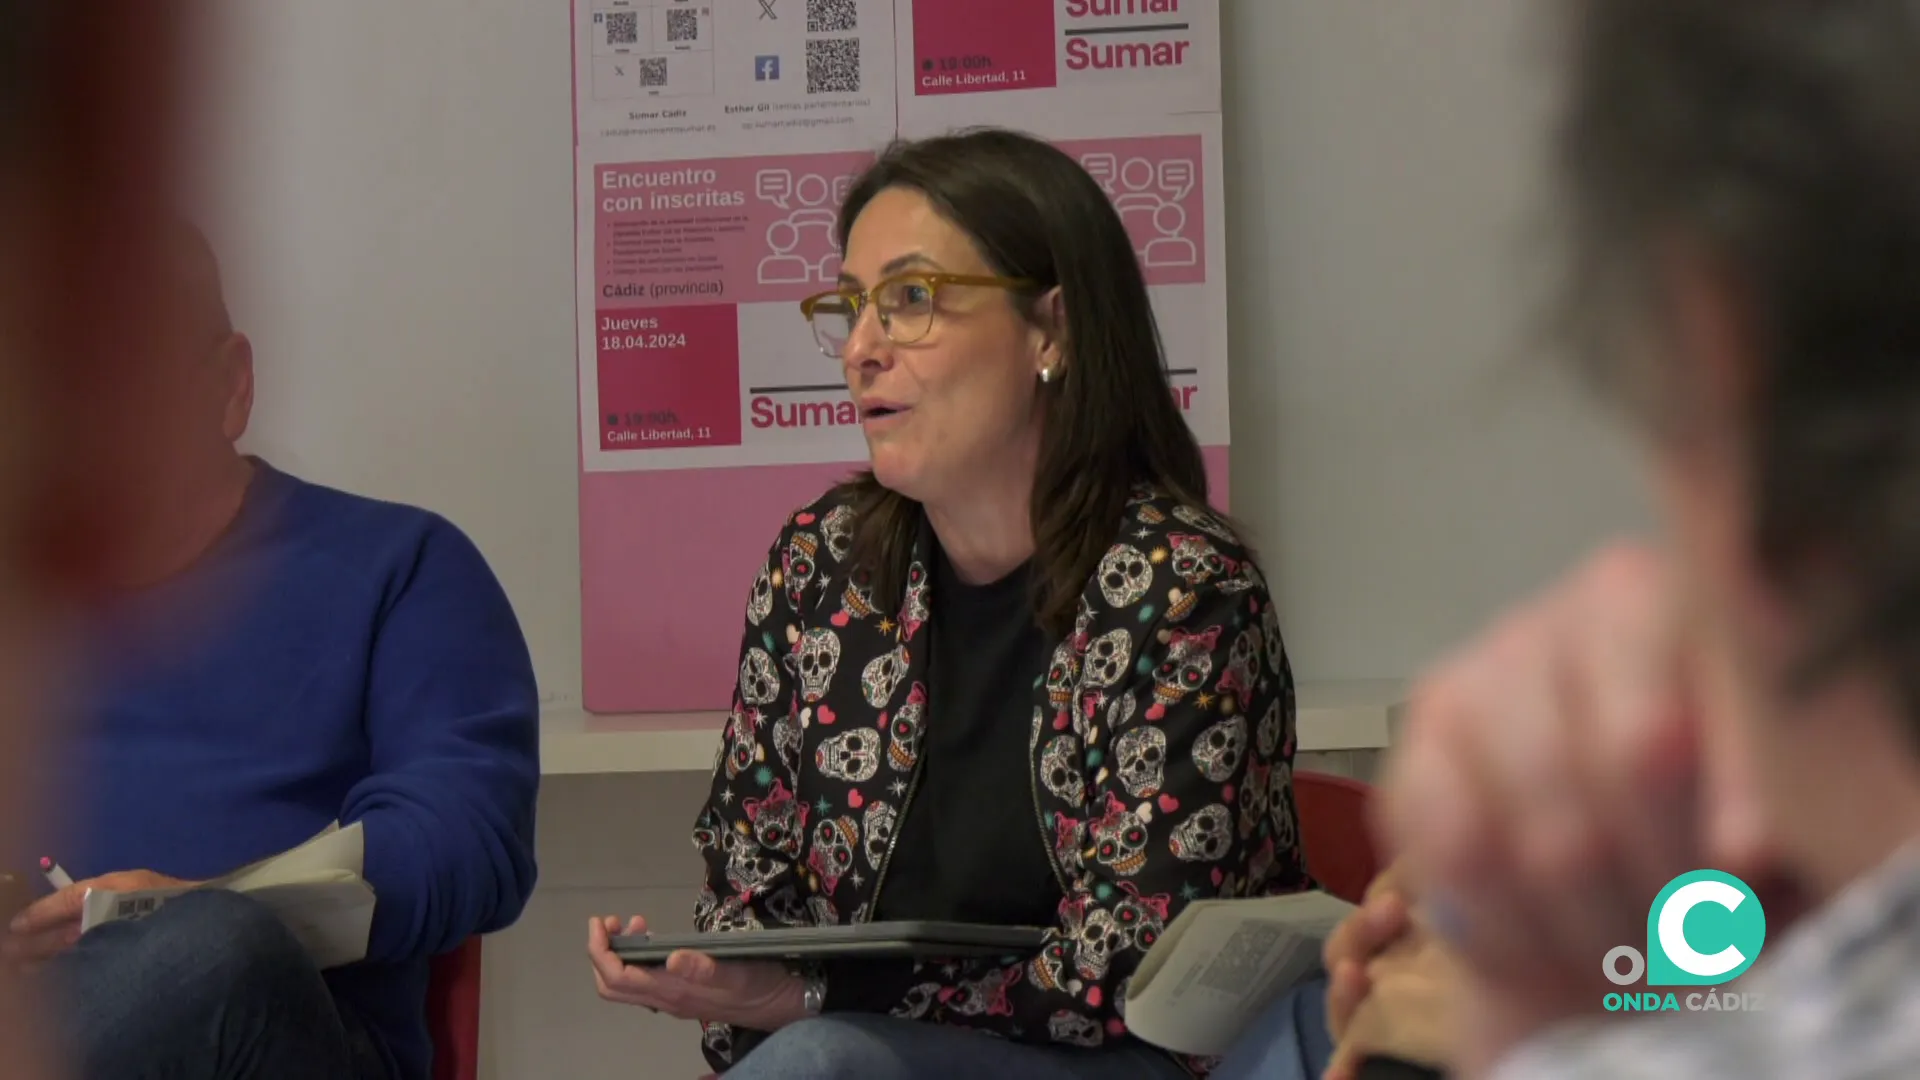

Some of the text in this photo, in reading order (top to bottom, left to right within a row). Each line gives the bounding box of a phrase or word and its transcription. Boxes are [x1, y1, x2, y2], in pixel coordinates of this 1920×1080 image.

[1065, 37, 1190, 70] Sumar
[922, 70, 1026, 88] Calle Libertad, 11
[629, 111, 659, 121] Sumar
[724, 103, 754, 114] Esther
[757, 102, 770, 112] Gil
[602, 168, 717, 190] Encuentro
[602, 189, 746, 213] con inscritas
[602, 280, 725, 299] Cádiz (provincia)
[601, 316, 659, 332] Jueves
[602, 333, 687, 350] 18.04.2024
[750, 396, 861, 429] Suma
[607, 427, 712, 442] Calle Libertad, 11
